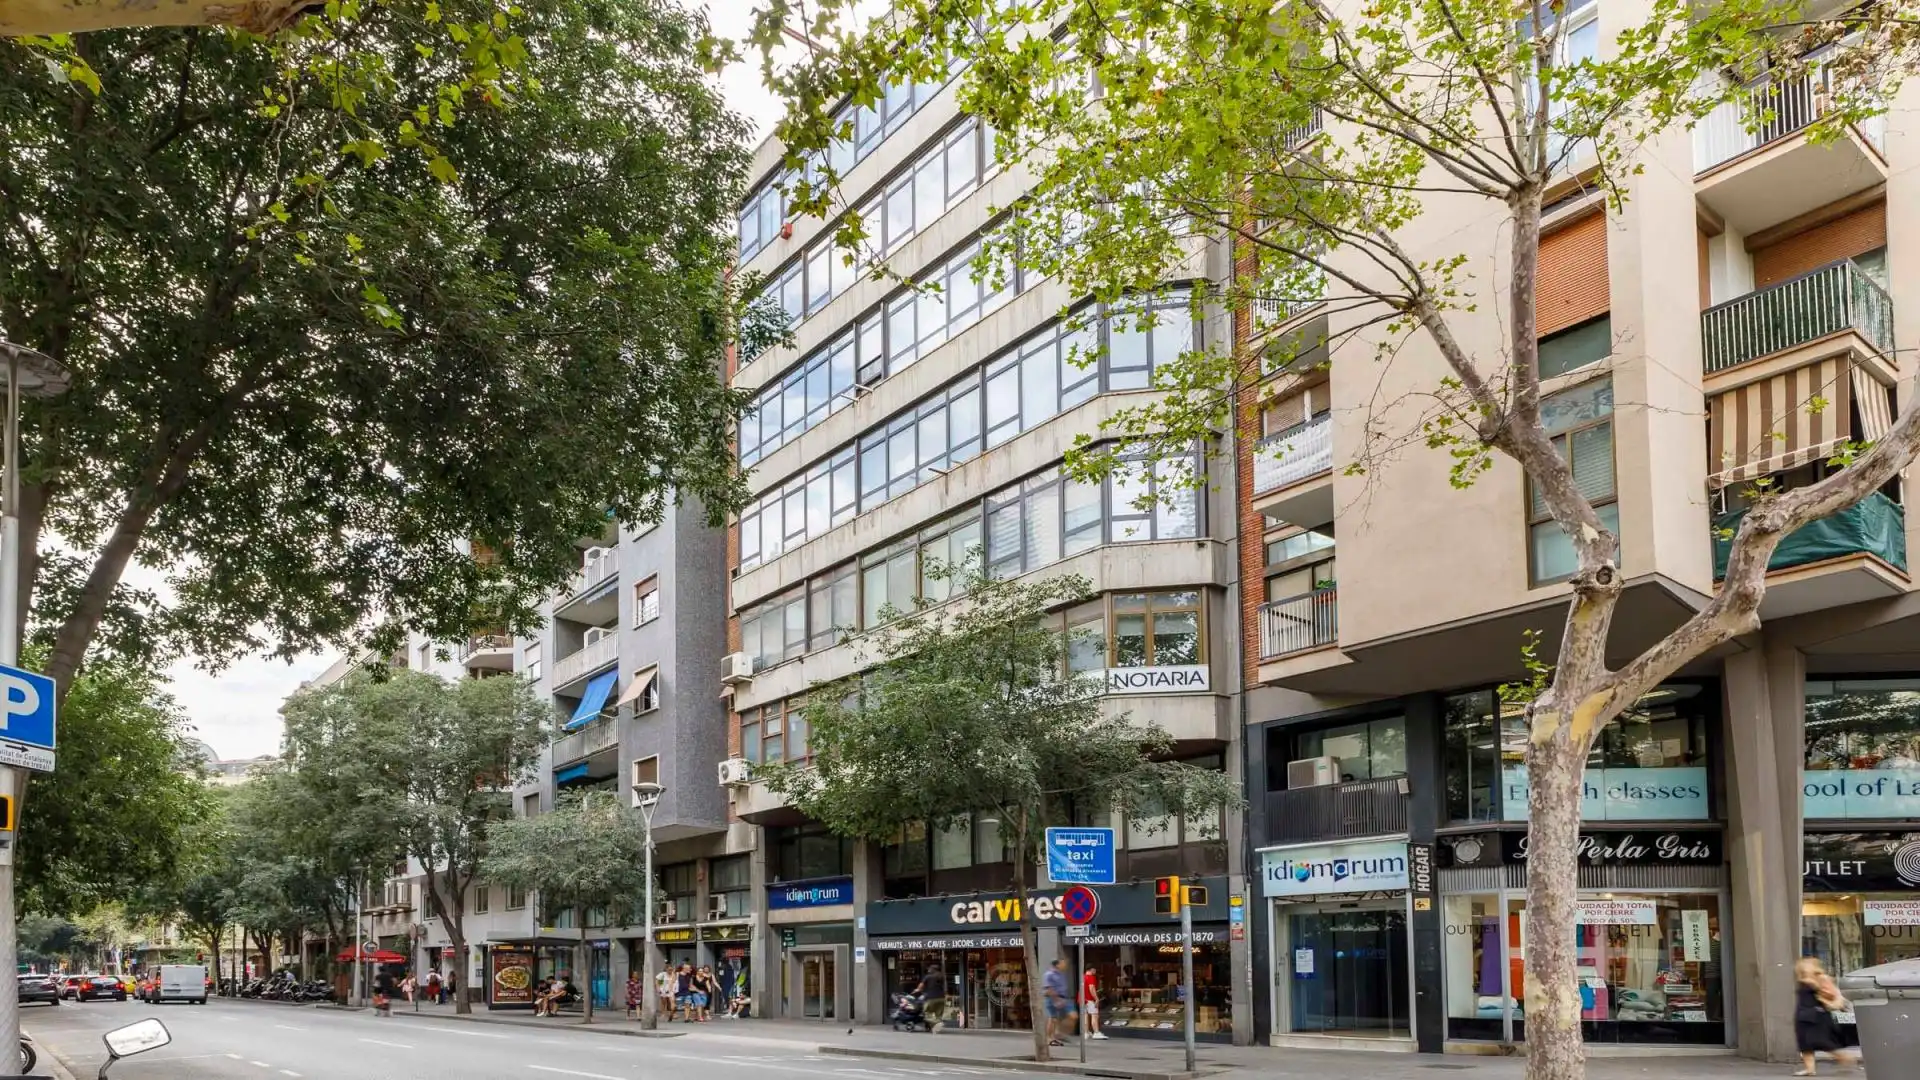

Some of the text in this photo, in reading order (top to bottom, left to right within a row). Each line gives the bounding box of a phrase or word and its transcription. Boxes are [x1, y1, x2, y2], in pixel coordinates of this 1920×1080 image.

[1113, 670, 1205, 688] NOTARIA
[0, 674, 40, 728] P
[1607, 782, 1700, 800] classes
[1803, 778, 1920, 797] ool of La
[1067, 849, 1094, 861] taxi
[1577, 834, 1650, 859] Perla
[1655, 836, 1710, 859] Gris
[1268, 856, 1404, 883] idiomarum
[1415, 847, 1431, 892] HOGAR
[1803, 860, 1867, 876] UTLET
[786, 887, 840, 903] idiomarum
[1866, 902, 1920, 911] LIQUIDACIÓ
[1074, 932, 1104, 944] PSSIÓ
[1107, 931, 1150, 944] VINÍCOLA
[1154, 933, 1171, 943] DES
[1192, 932, 1214, 942] 1870
[1870, 925, 1914, 937] OUT
[877, 941, 903, 950] VERMUTS
[908, 940, 922, 949] VINS
[927, 940, 946, 949] CAVES
[952, 939, 974, 948] LICORS
